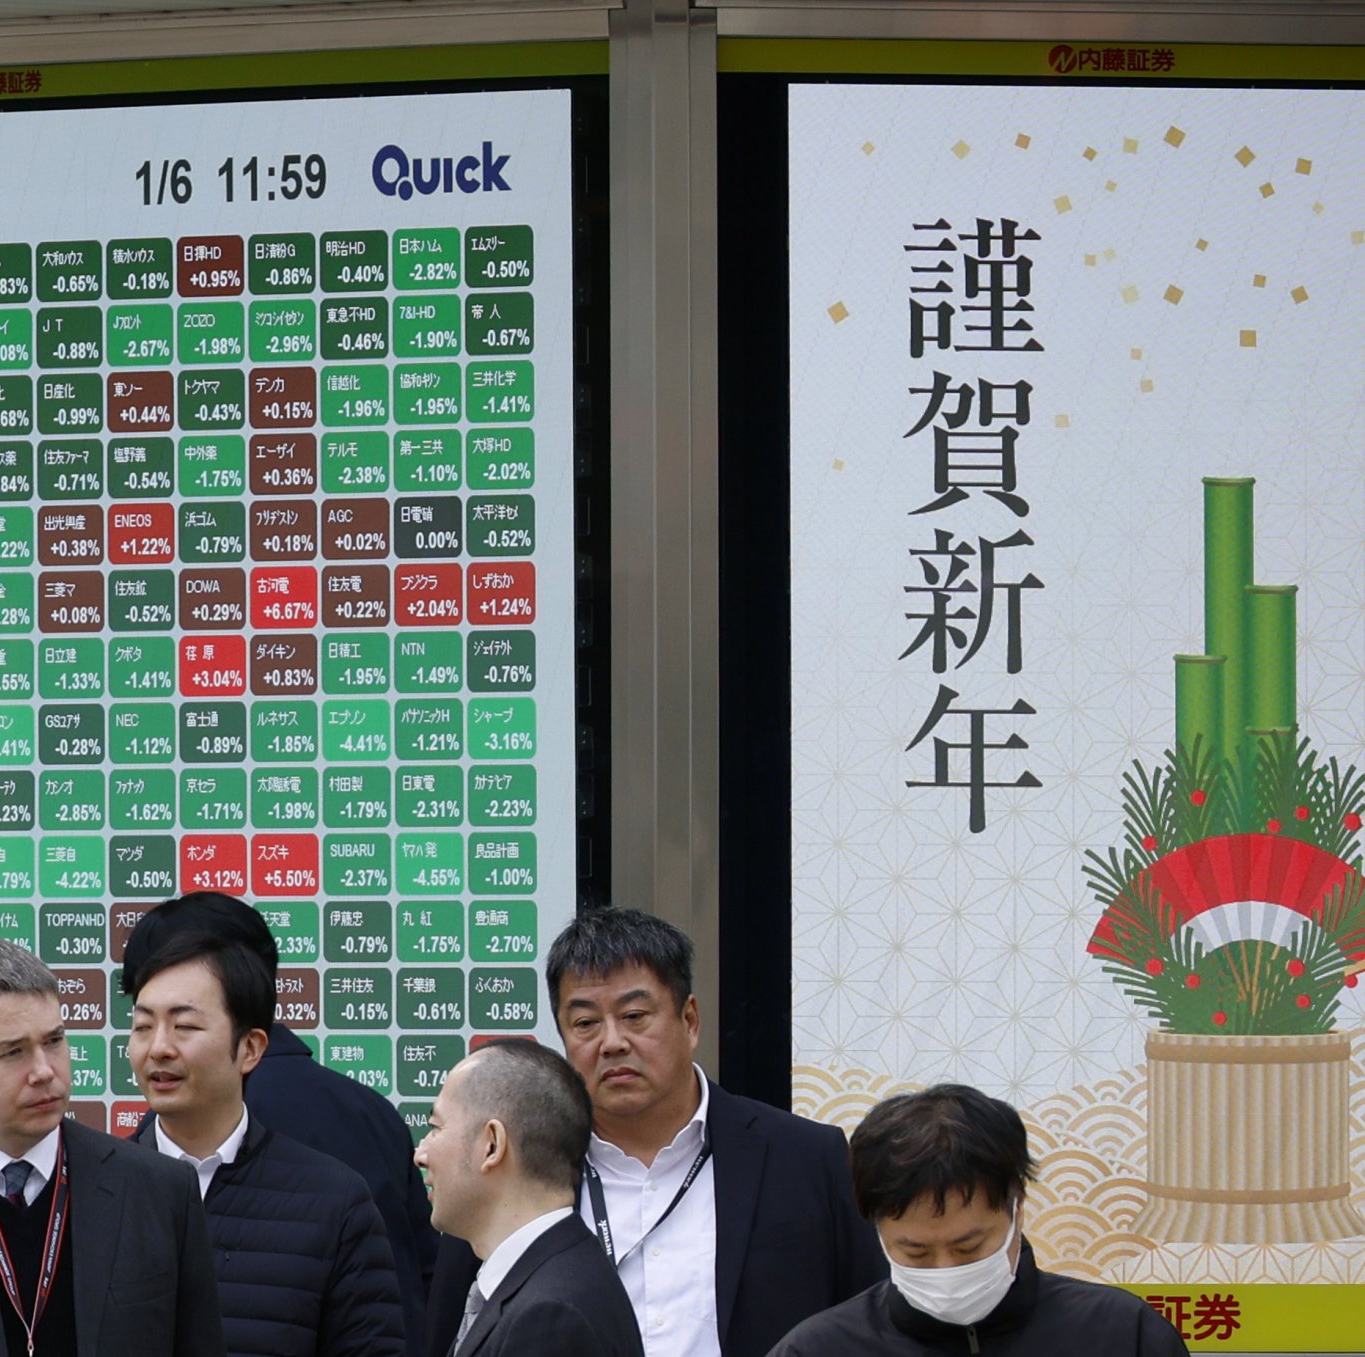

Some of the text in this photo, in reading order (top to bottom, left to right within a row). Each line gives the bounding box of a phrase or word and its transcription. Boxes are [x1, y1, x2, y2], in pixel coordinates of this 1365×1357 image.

[1079, 48, 1174, 71] 内藤証券
[136, 154, 326, 205] 1/6 11:59
[326, 241, 365, 256] 明治HD
[400, 238, 442, 254] 日本ハム
[337, 265, 385, 283] -0.40%
[409, 263, 458, 280] -2.82%
[184, 314, 215, 327] ZOZO
[327, 307, 375, 323] 東急不HD
[400, 305, 435, 319] 7&I-HD
[194, 338, 242, 355] -1.98%
[338, 333, 385, 350] -0.46%
[410, 331, 458, 348] -1.90%
[327, 375, 360, 391] 信越化
[472, 370, 516, 387] 三井化学
[338, 400, 386, 417] -1.96%
[483, 396, 531, 413] -1.41%
[185, 445, 217, 460] 中外薬
[400, 439, 443, 455] 第一三共
[473, 438, 511, 453] 大塚HD
[195, 470, 243, 487] -1.75%
[411, 465, 459, 482] -1.10%
[483, 463, 532, 480] -2.02%
[115, 514, 151, 527] ENEOS
[328, 509, 353, 522] AGC
[899, 218, 1044, 833] 謹賀新年
[121, 538, 172, 555] +1.22%
[335, 533, 386, 550] +0.02%
[186, 580, 220, 593] DOWA
[257, 577, 289, 594] 古河電
[473, 573, 514, 589] しずおか
[192, 604, 243, 621] +0.29%
[263, 603, 315, 619] +6.67%
[480, 598, 532, 615] +1.24%
[45, 648, 77, 663] 日立建
[402, 643, 425, 655] NTN
[55, 672, 102, 689] -1.33%
[411, 666, 460, 684] -1.49%
[116, 714, 139, 727] NEC
[186, 711, 218, 727] 富士通
[126, 737, 173, 754] -1.12%
[196, 737, 244, 753] -0.89%
[329, 776, 362, 791] 村田製
[402, 775, 435, 792] 日東電
[340, 801, 388, 818] -1.79%
[412, 800, 461, 818] -2.31%
[330, 844, 375, 857] SUBARU
[475, 842, 519, 858] 良品計画
[340, 869, 388, 886] -2.37%
[485, 868, 534, 885] -1.00%
[46, 913, 105, 926] TOPPANHD
[330, 911, 363, 926] 伊藤忠
[56, 938, 103, 954] -0.30%
[341, 936, 389, 953] -0.79%
[330, 978, 374, 993] 三井住友
[341, 1003, 389, 1020] -0.15%
[1146, 1293, 1241, 1341] 証券
